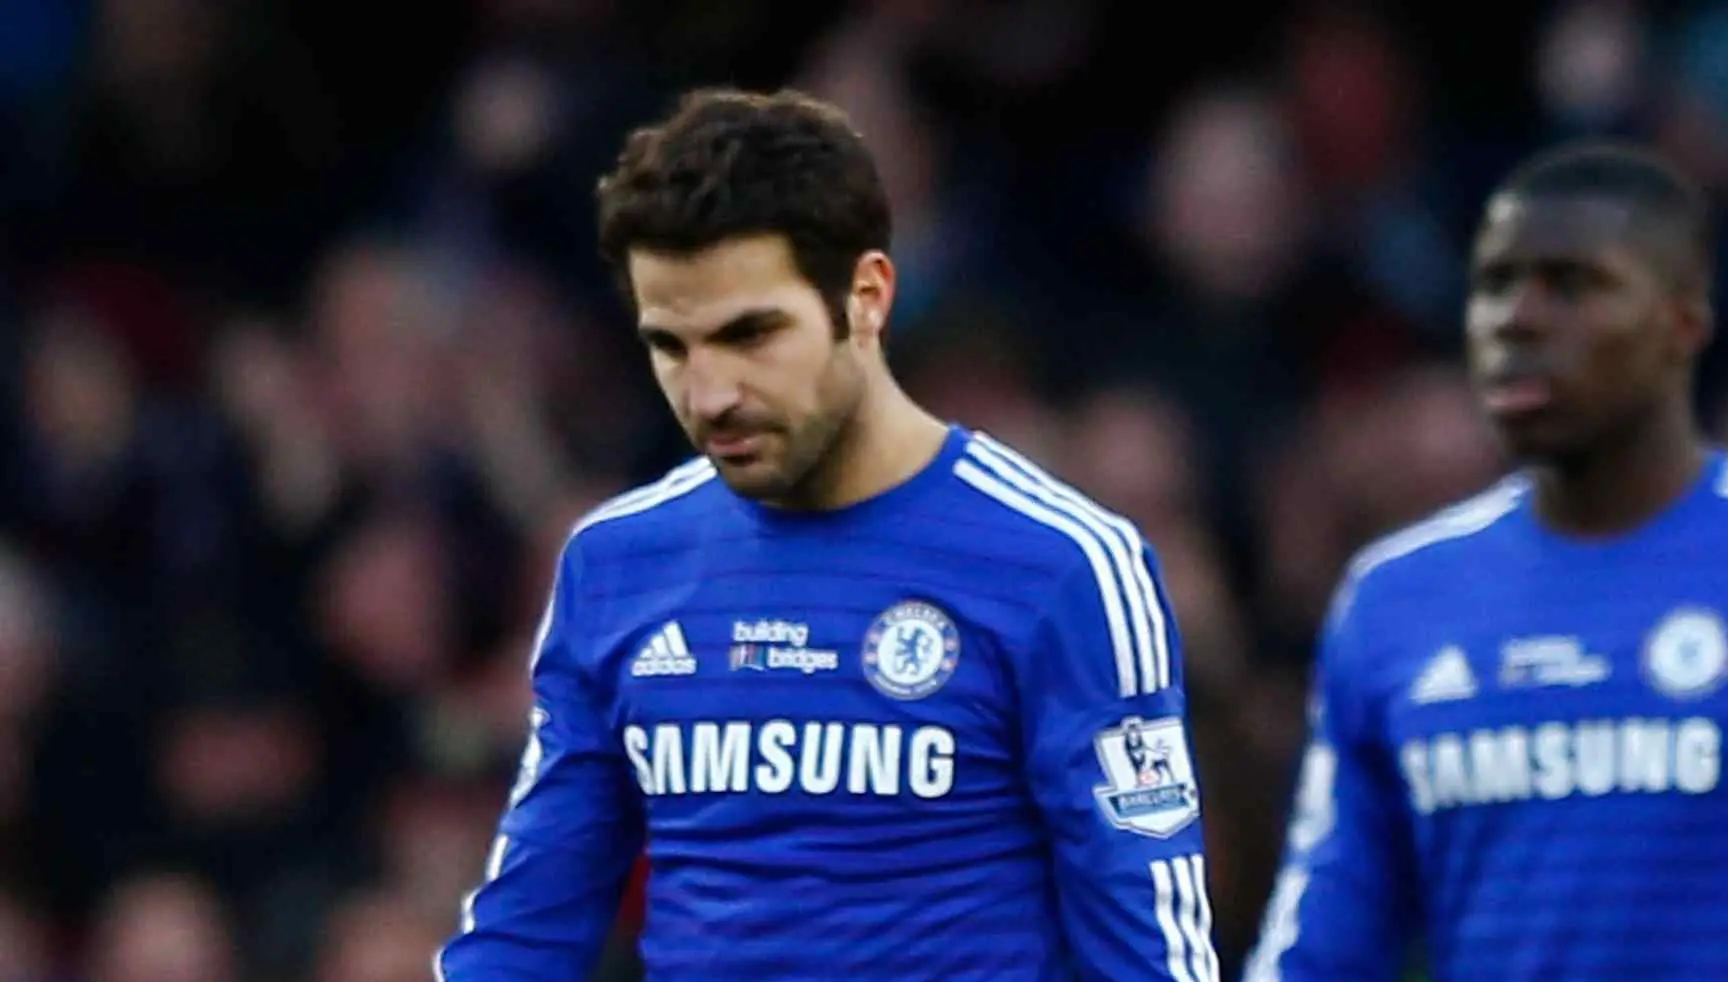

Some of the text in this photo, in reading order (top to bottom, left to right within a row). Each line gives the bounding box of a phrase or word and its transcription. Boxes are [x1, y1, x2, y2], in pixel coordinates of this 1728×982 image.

[734, 620, 808, 647] building
[631, 657, 697, 676] adidas
[767, 647, 838, 674] bridges
[624, 719, 956, 798] SAMSUNG
[1404, 717, 1721, 814] SAMSUNG
